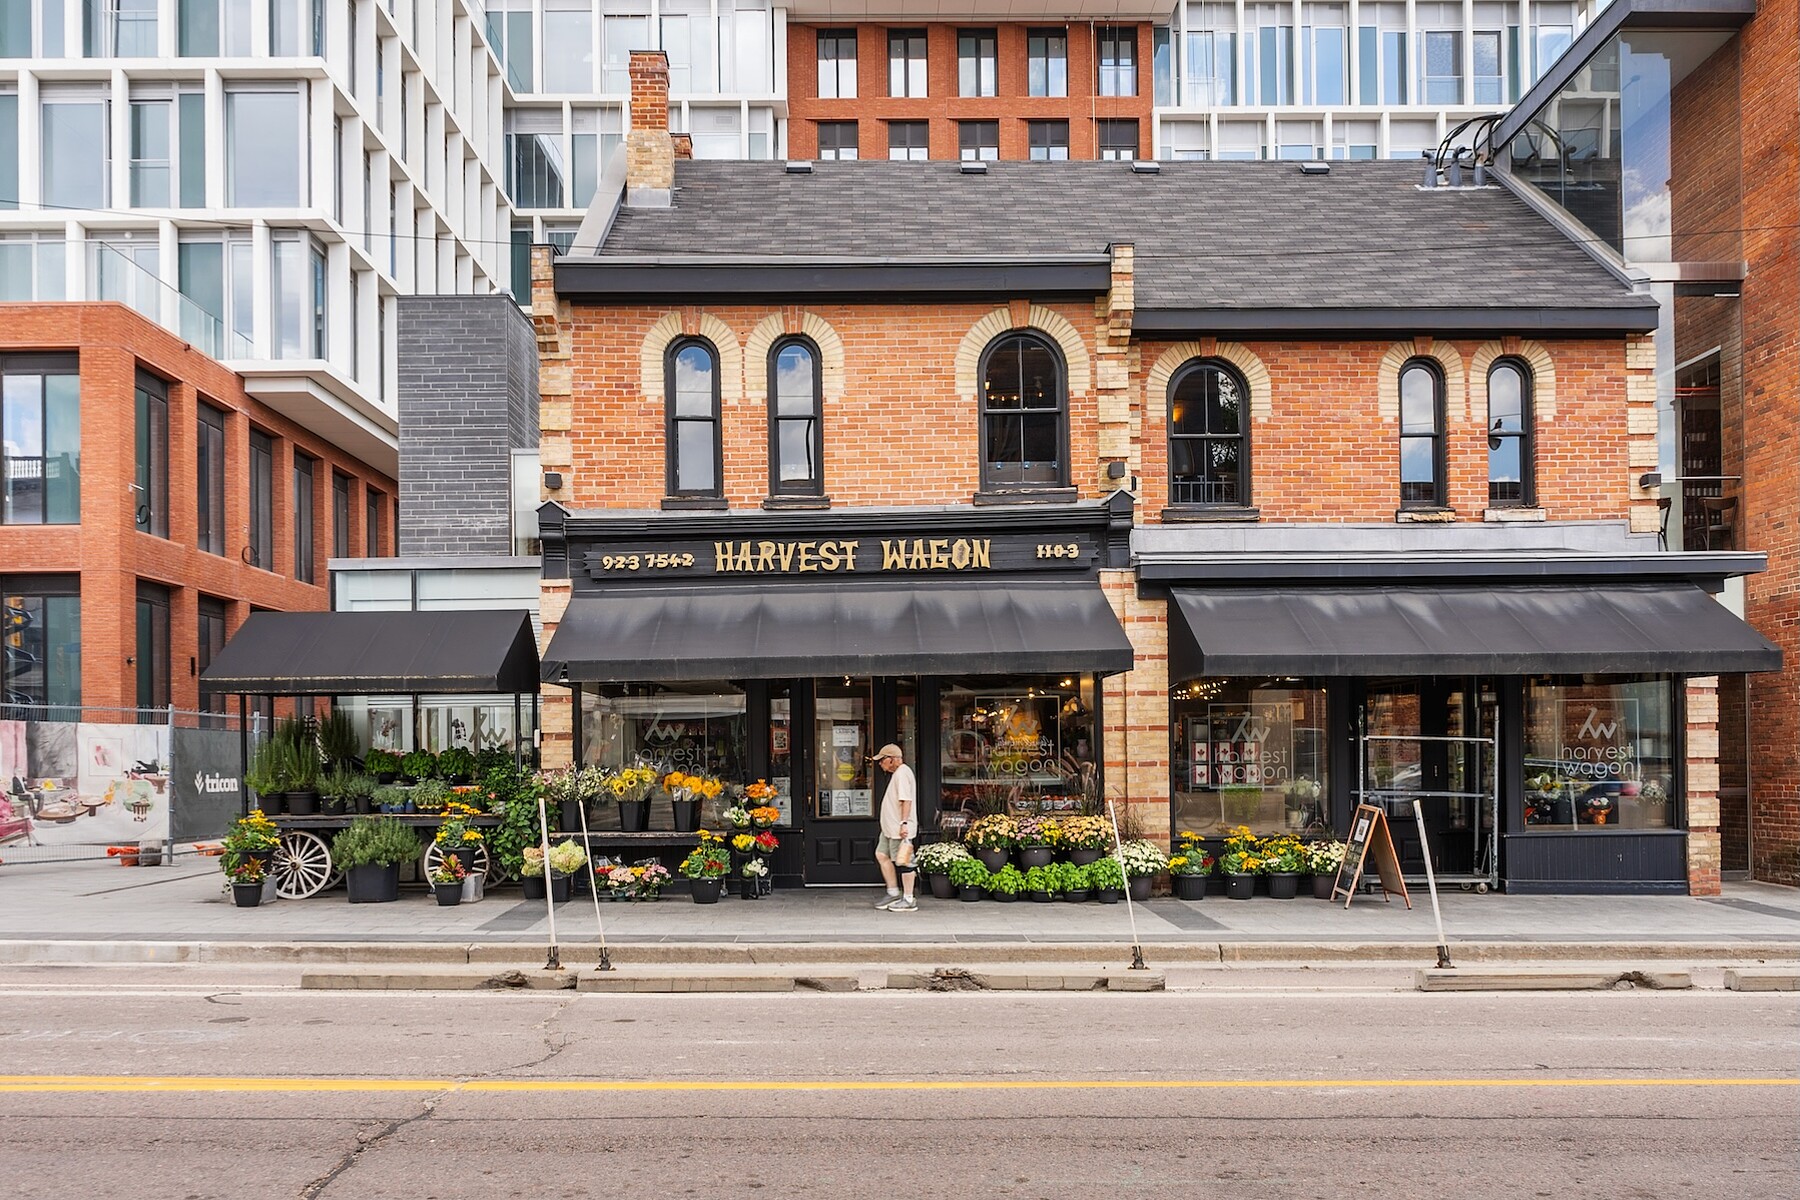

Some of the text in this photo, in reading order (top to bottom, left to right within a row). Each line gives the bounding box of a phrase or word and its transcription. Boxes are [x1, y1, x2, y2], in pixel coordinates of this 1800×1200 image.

[602, 553, 695, 571] 923 7542
[713, 538, 991, 573] HARVEST WAGON
[1214, 746, 1288, 764] harvest
[1561, 742, 1634, 760] harvest
[982, 759, 1056, 777] wagon
[1215, 766, 1288, 783] wagon
[1561, 761, 1634, 779] wagon
[204, 772, 239, 793] tricon
